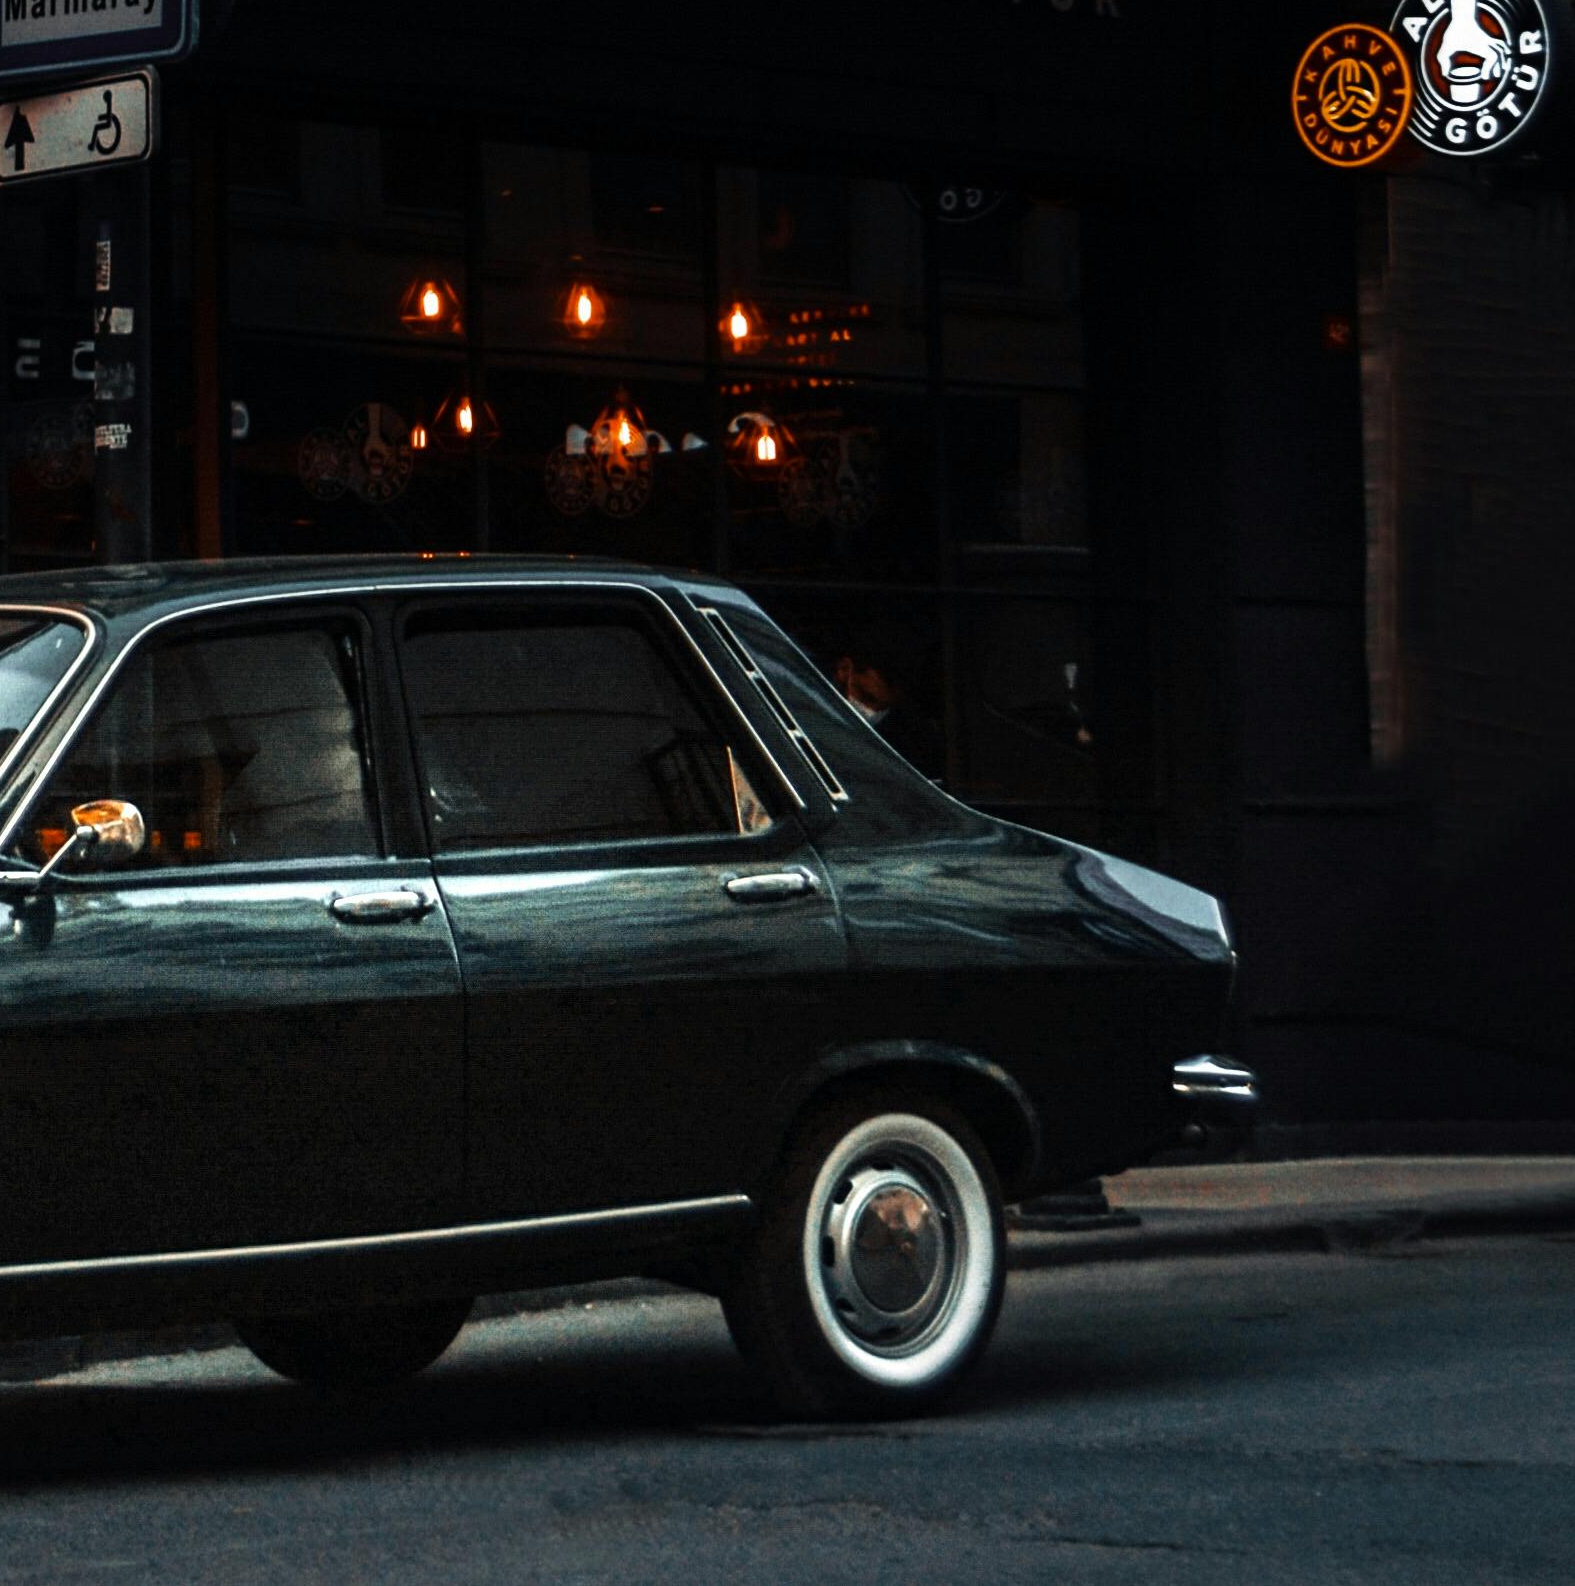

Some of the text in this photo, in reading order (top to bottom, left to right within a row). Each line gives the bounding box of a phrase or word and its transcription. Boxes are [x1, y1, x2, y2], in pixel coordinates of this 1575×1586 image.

[1304, 35, 1397, 84] KAHVE
[1445, 29, 1544, 144] GÖTÜR
[1303, 106, 1398, 155] DÜNYASI
